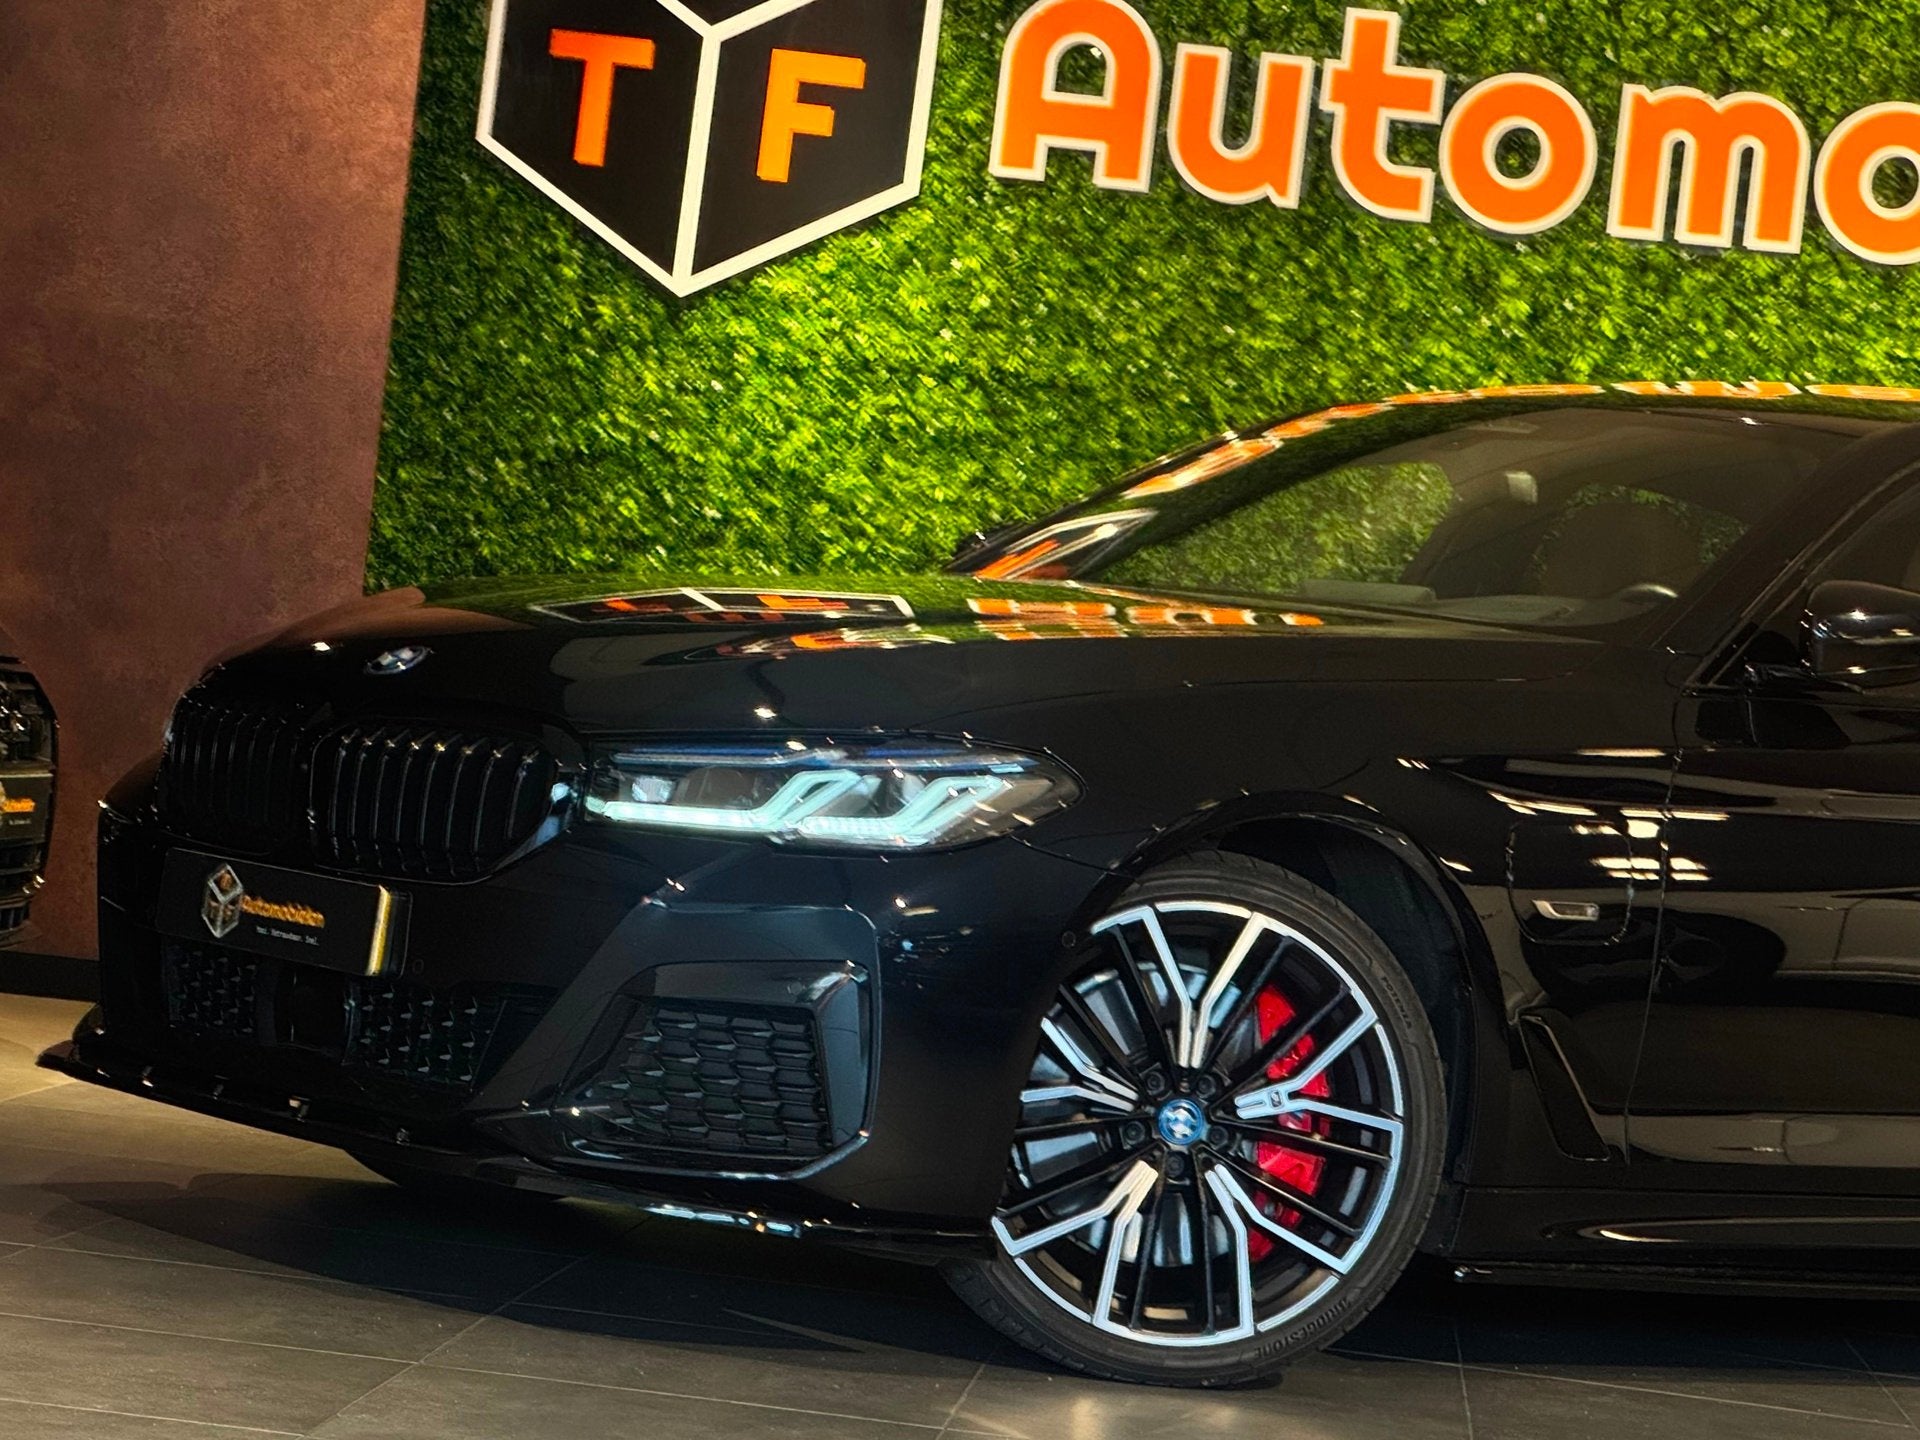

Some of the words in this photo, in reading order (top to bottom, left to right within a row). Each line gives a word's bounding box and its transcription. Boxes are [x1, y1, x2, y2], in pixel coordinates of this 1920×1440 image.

[549, 29, 655, 167] T
[756, 48, 866, 184] F
[989, 0, 1920, 265] Automo
[1254, 1297, 1351, 1359] BRIDGESTONE
